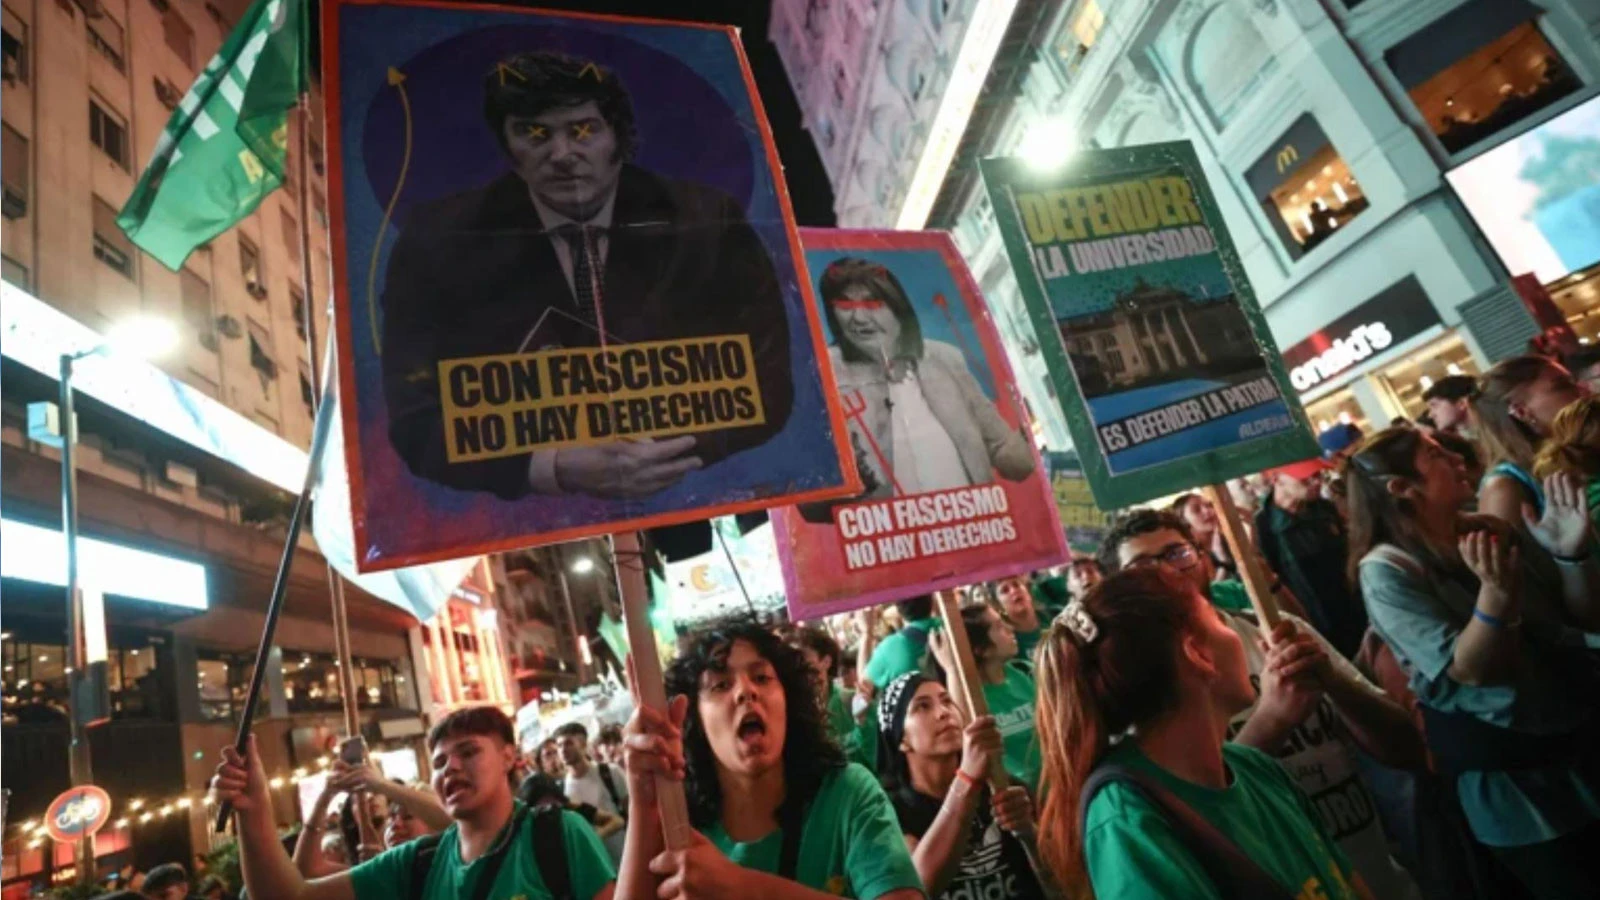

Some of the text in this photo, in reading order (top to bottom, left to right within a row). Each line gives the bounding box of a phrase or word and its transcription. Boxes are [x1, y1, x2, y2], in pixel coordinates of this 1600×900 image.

[1019, 176, 1203, 245] DEFENDER
[1036, 225, 1216, 279] LA UNIVERSIDAD
[449, 340, 746, 408] CON FASCISMO
[1290, 321, 1392, 390] onald's
[454, 387, 756, 455] NO HAY DERECHOS
[1101, 425, 1127, 451] ES
[1125, 401, 1206, 444] DEFENDER
[1204, 392, 1227, 419] LA
[1222, 377, 1280, 411] PATRIA
[839, 503, 893, 538] CON
[894, 485, 1008, 529] FASCISMO
[845, 517, 1016, 569] NO HAY DERECHOS
